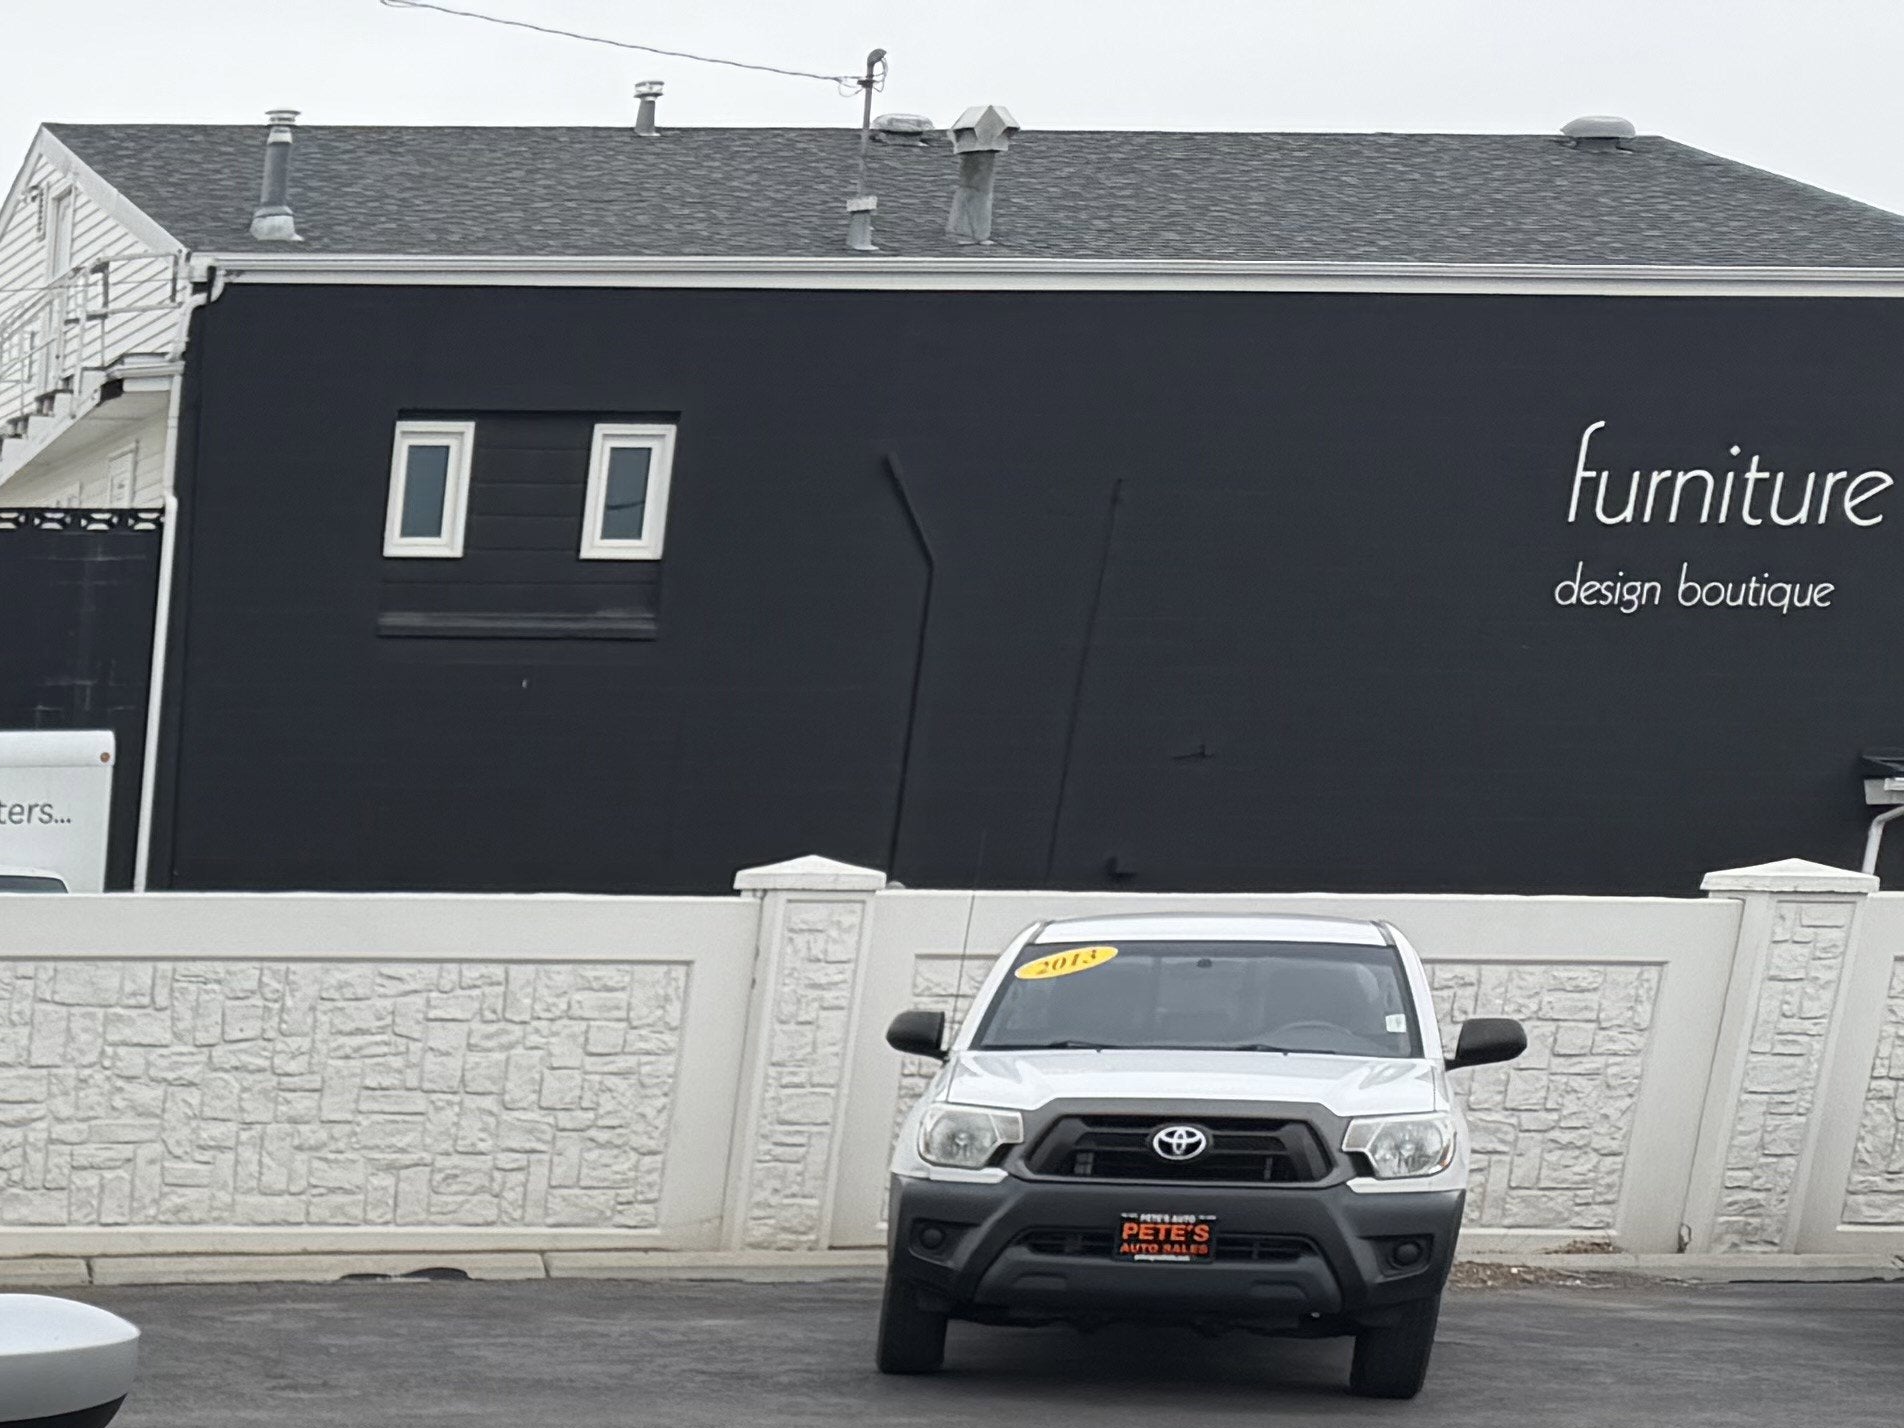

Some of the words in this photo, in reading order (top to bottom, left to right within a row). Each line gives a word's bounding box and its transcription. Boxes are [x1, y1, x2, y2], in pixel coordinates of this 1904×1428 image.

[1566, 420, 1896, 528] furniture
[1554, 560, 1662, 614] design
[1677, 562, 1836, 616] boutique
[1120, 1243, 1159, 1253] AUTO
[1122, 1222, 1210, 1241] PETE'S
